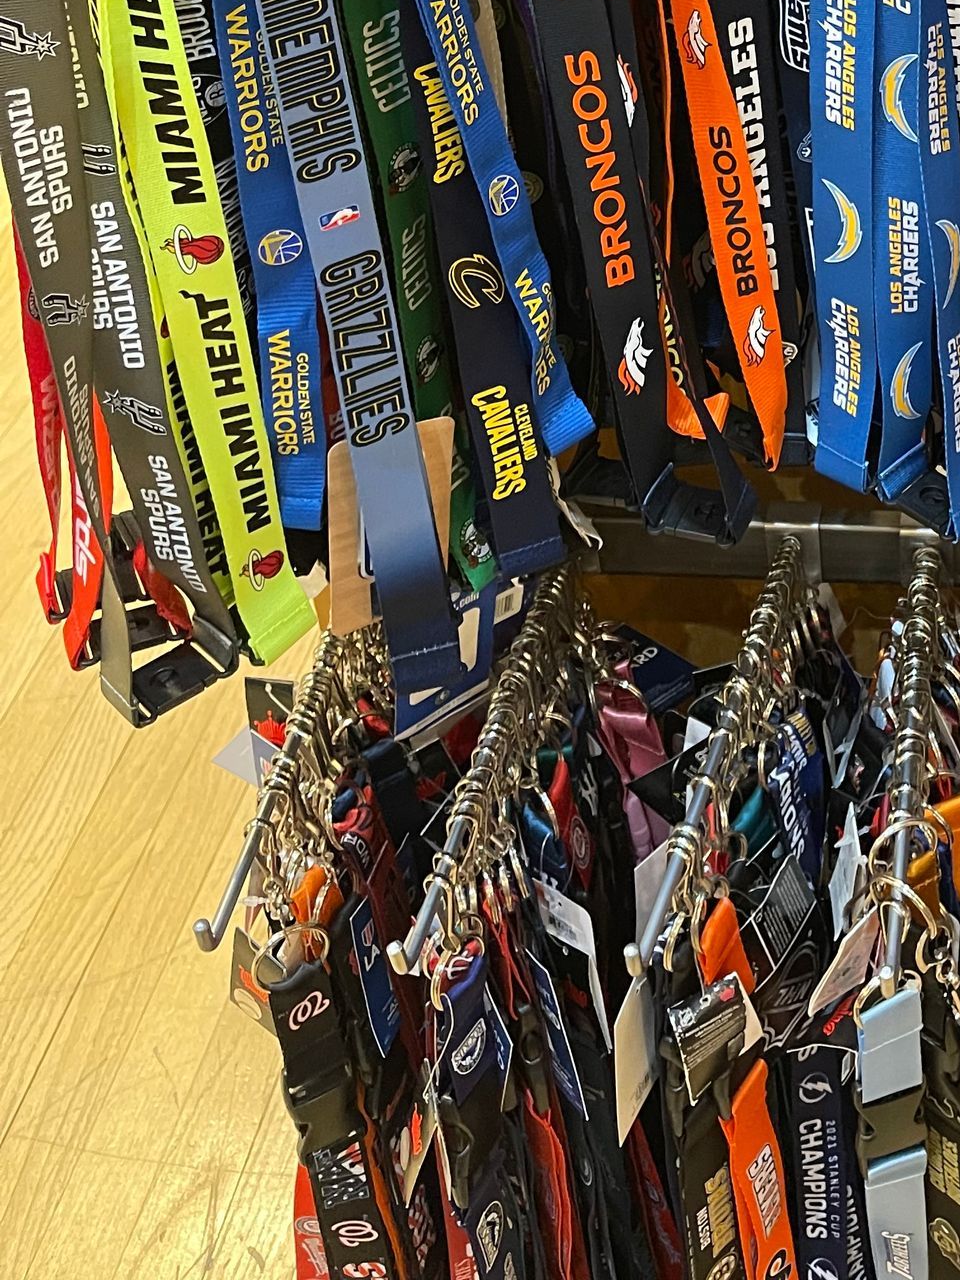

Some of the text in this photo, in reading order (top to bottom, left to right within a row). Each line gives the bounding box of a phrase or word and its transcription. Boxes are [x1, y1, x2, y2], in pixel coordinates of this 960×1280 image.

[226, 4, 269, 173] WARRIORS
[362, 9, 412, 114] CELTICS
[464, 48, 484, 100] STATE
[727, 15, 772, 207] ANGELES
[842, 42, 856, 132] ANGELES
[924, 24, 942, 155] CHARGERS
[936, 22, 951, 152] LOS ANGELES
[5, 87, 60, 269] SAN ANTONIO
[39, 125, 73, 216] SPURS
[138, 60, 207, 206] MIAMI
[266, 97, 284, 147] STATE
[414, 61, 467, 185] CAVALIERS
[564, 50, 636, 289] BRONCOS
[402, 215, 433, 312] CELTICS
[707, 124, 761, 298] BRONCOS
[888, 196, 902, 315] LOS ANGELES
[901, 199, 926, 314] CHARGERS
[91, 202, 146, 370] SAN ANTONIO
[267, 329, 299, 457] WARRIORS
[296, 352, 315, 445] GOLDEN STATE
[320, 249, 410, 448] GRIZZLIES
[825, 296, 848, 412] CHARGERS
[846, 304, 863, 418] LOS ANGELES
[179, 290, 271, 534] MIAMI HEAT
[471, 384, 528, 501] CAVALIERS
[513, 404, 539, 463] CLEVELAND
[140, 488, 176, 562] SPURS
[148, 454, 208, 595] SAN ANTONIO
[696, 1207, 712, 1251] BOSTON
[799, 1118, 828, 1241] CHAMPIONS
[826, 1119, 842, 1239] 2021 STANLEY CUP
